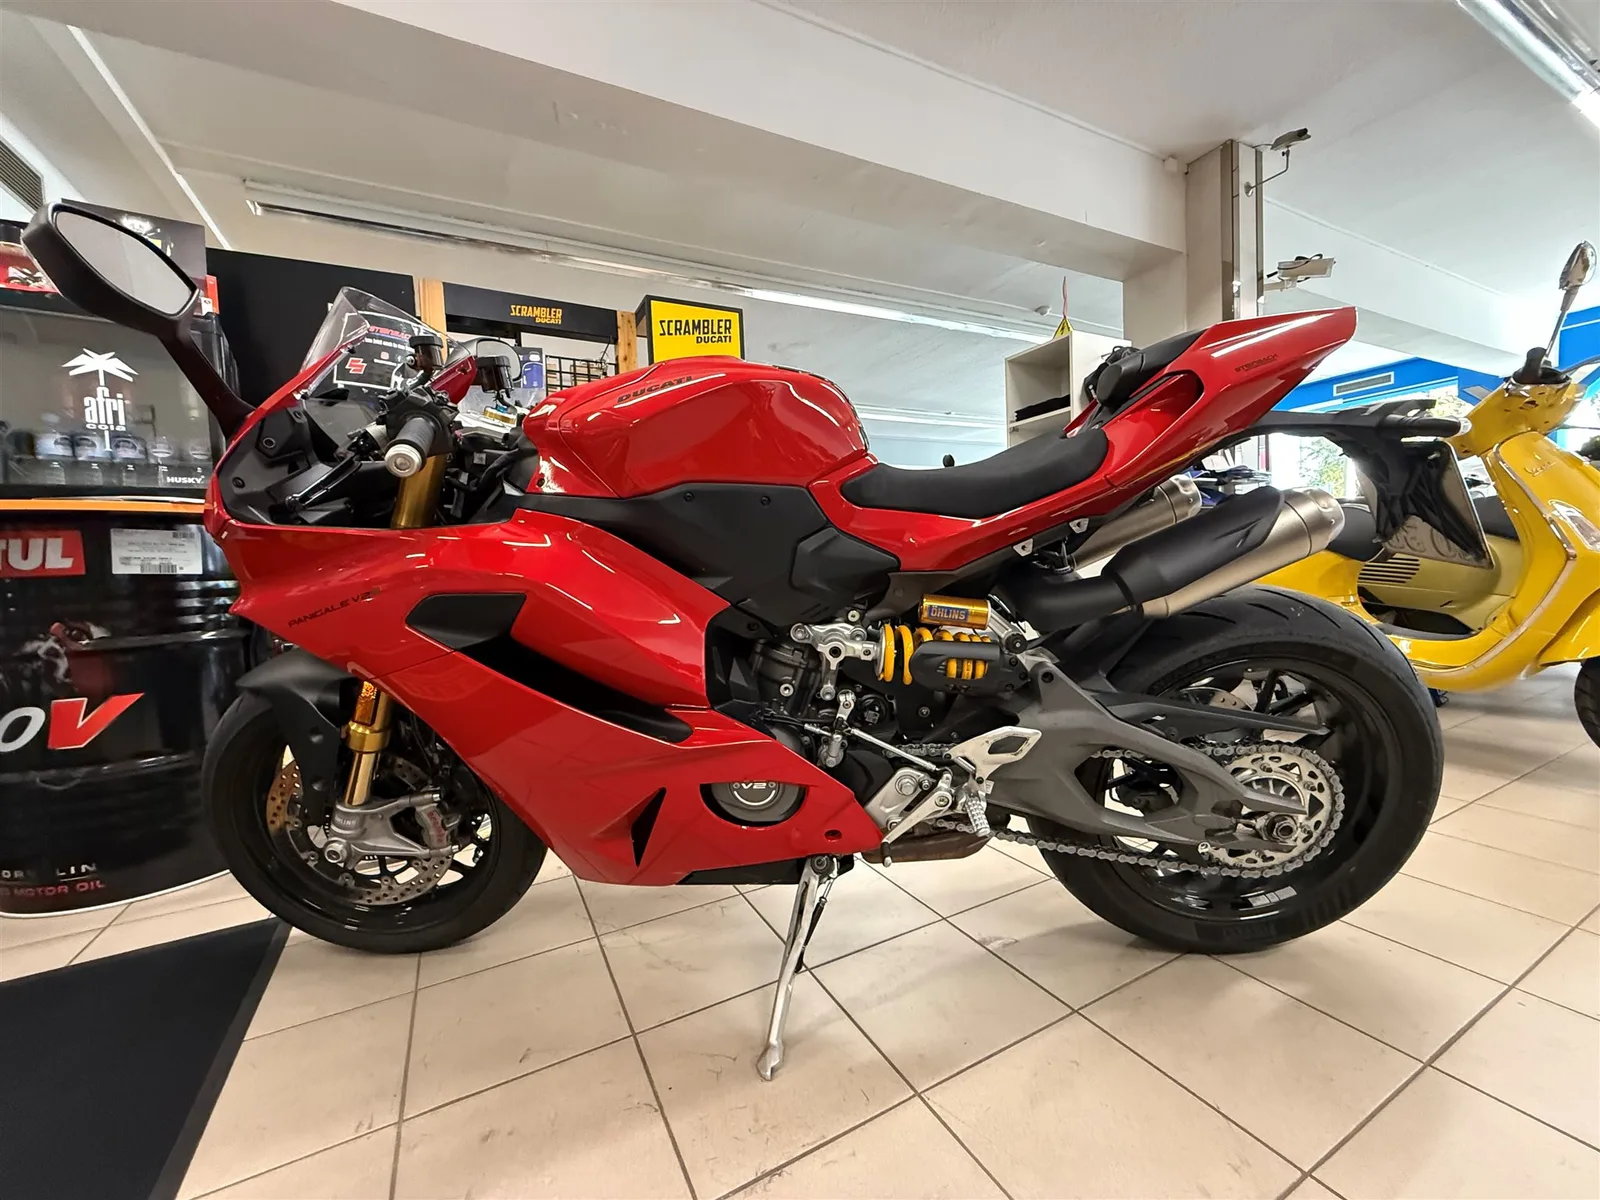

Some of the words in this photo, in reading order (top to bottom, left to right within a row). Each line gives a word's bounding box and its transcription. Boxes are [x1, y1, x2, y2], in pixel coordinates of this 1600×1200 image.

[510, 304, 562, 319] SCRAMBLER
[535, 317, 562, 325] DUCATI
[659, 319, 732, 336] SCRAMBLER
[696, 335, 732, 344] DUCATI
[617, 375, 694, 403] DUCATI
[83, 386, 126, 425] afri
[85, 423, 126, 431] cola
[0, 538, 74, 571] UL
[288, 599, 350, 628] PANIGALE
[351, 591, 371, 603] V2
[930, 605, 966, 620] ÖHLINS
[75, 880, 106, 892] OIL
